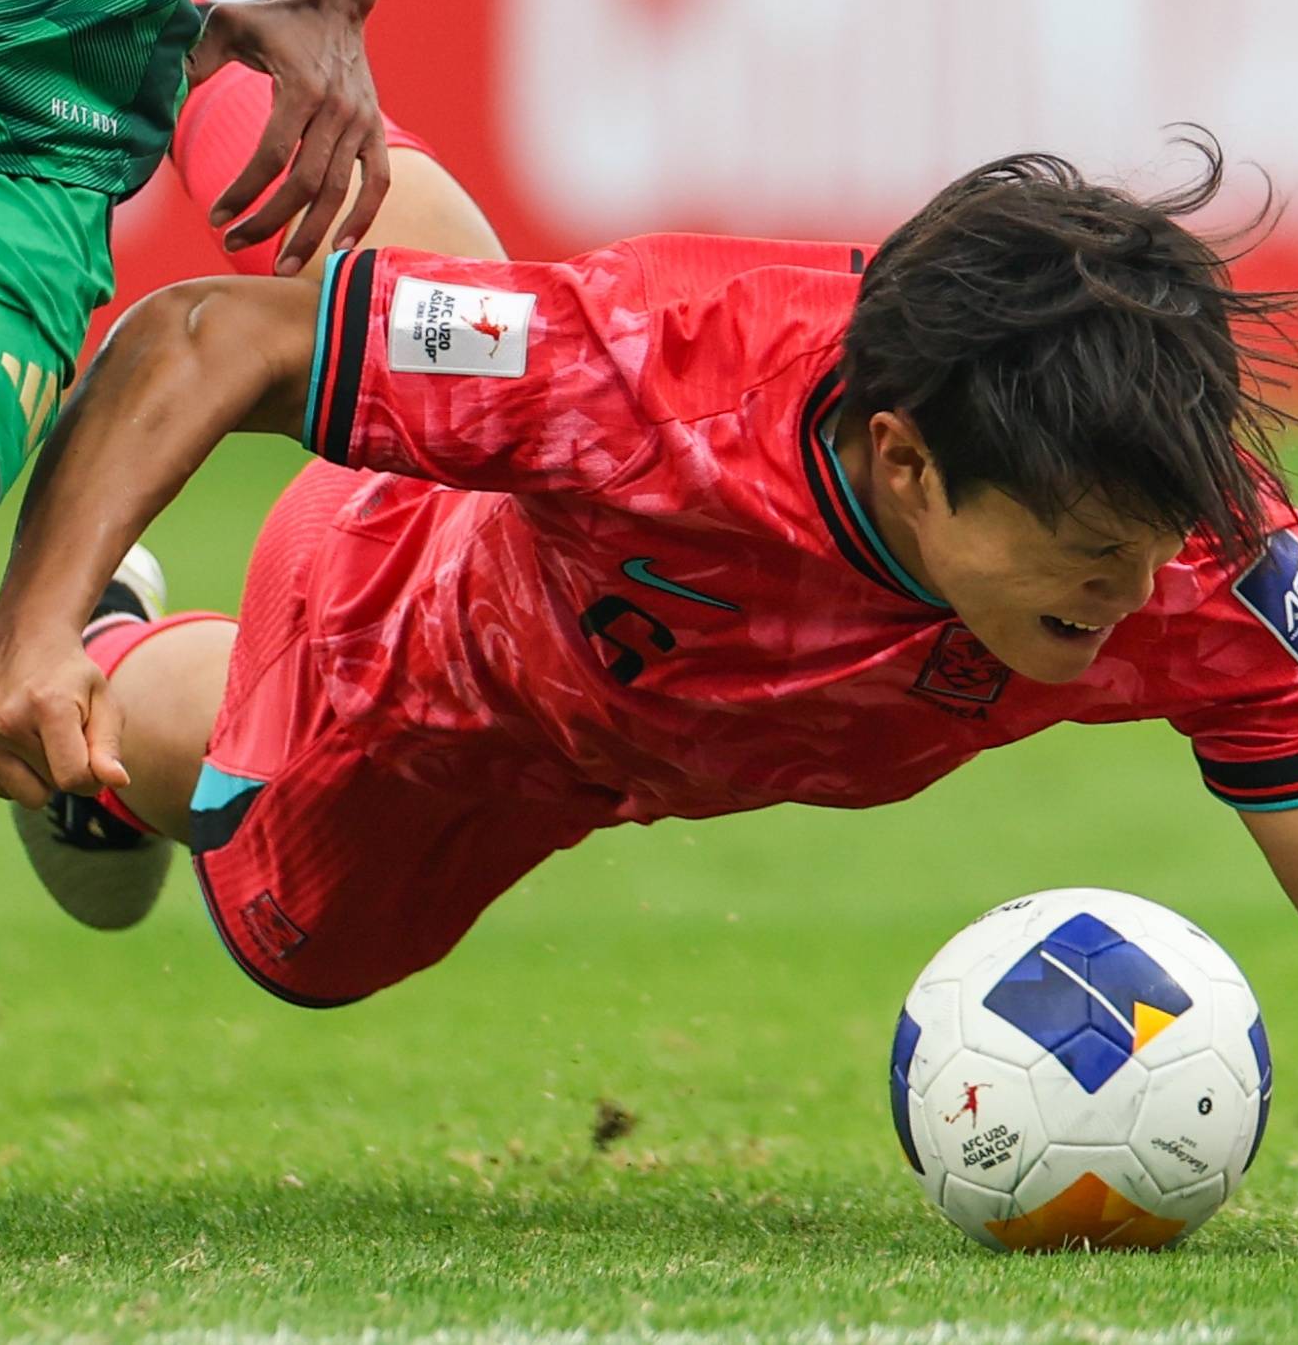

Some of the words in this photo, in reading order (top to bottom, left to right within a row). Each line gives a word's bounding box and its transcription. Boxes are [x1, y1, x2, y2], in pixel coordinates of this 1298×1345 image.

[427, 289, 444, 323] ASIAN
[441, 295, 455, 318] AFC
[425, 327, 437, 362] CUP
[438, 321, 451, 351] U20
[962, 1136, 984, 1154] AFC
[983, 1124, 1008, 1142] U20
[963, 1145, 996, 1168] ASIAN
[995, 1133, 1019, 1151] CUP
